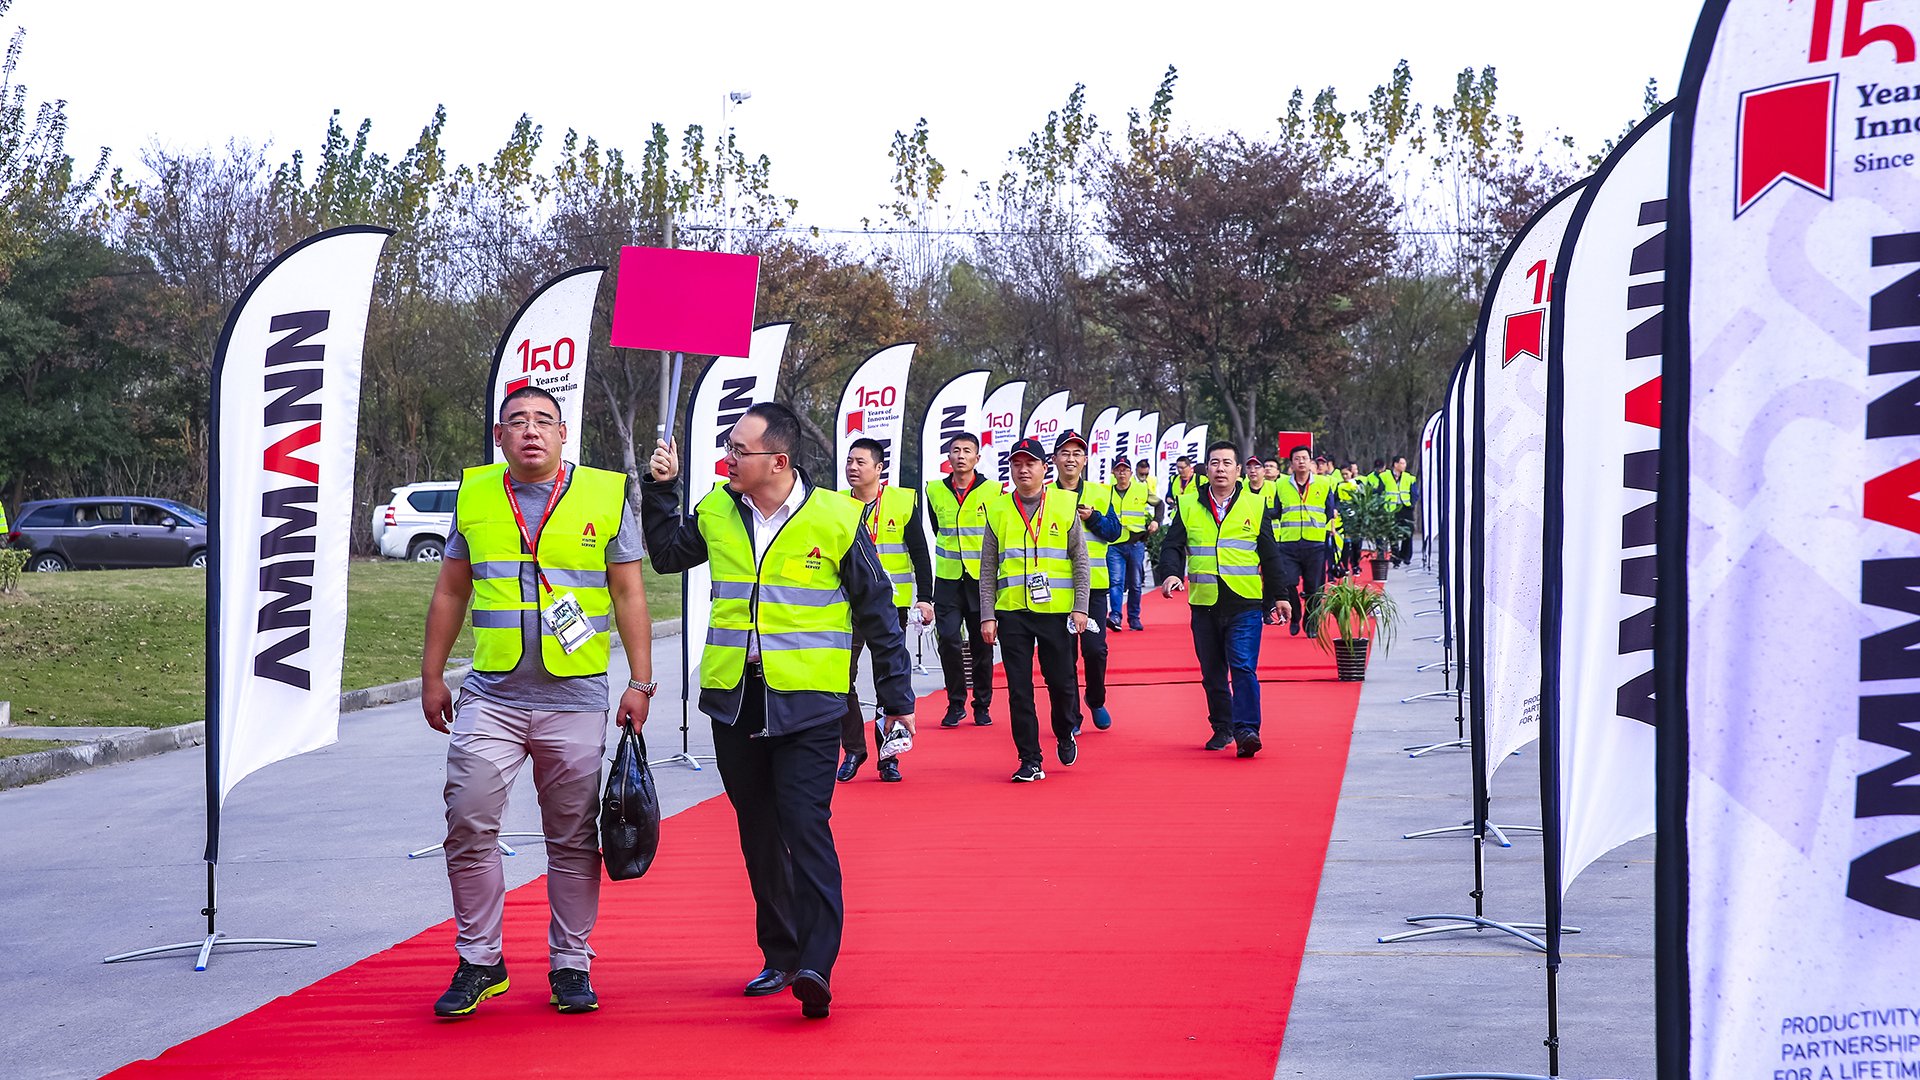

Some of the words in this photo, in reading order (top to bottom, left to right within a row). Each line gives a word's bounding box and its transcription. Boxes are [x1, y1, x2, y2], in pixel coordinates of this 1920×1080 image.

[1856, 83, 1920, 108] Year
[1854, 152, 1915, 173] Since
[516, 337, 575, 373] 150
[535, 376, 559, 387] Years
[560, 372, 570, 382] of
[855, 385, 897, 408] 150
[986, 412, 1014, 429] 150
[1034, 418, 1058, 434] 150
[254, 309, 330, 691] AMMANN
[1781, 1007, 1920, 1036] PRODUCTIVITY
[1781, 1034, 1920, 1061] PARTNERSHIP
[1839, 1060, 1920, 1080] LIFETIM
